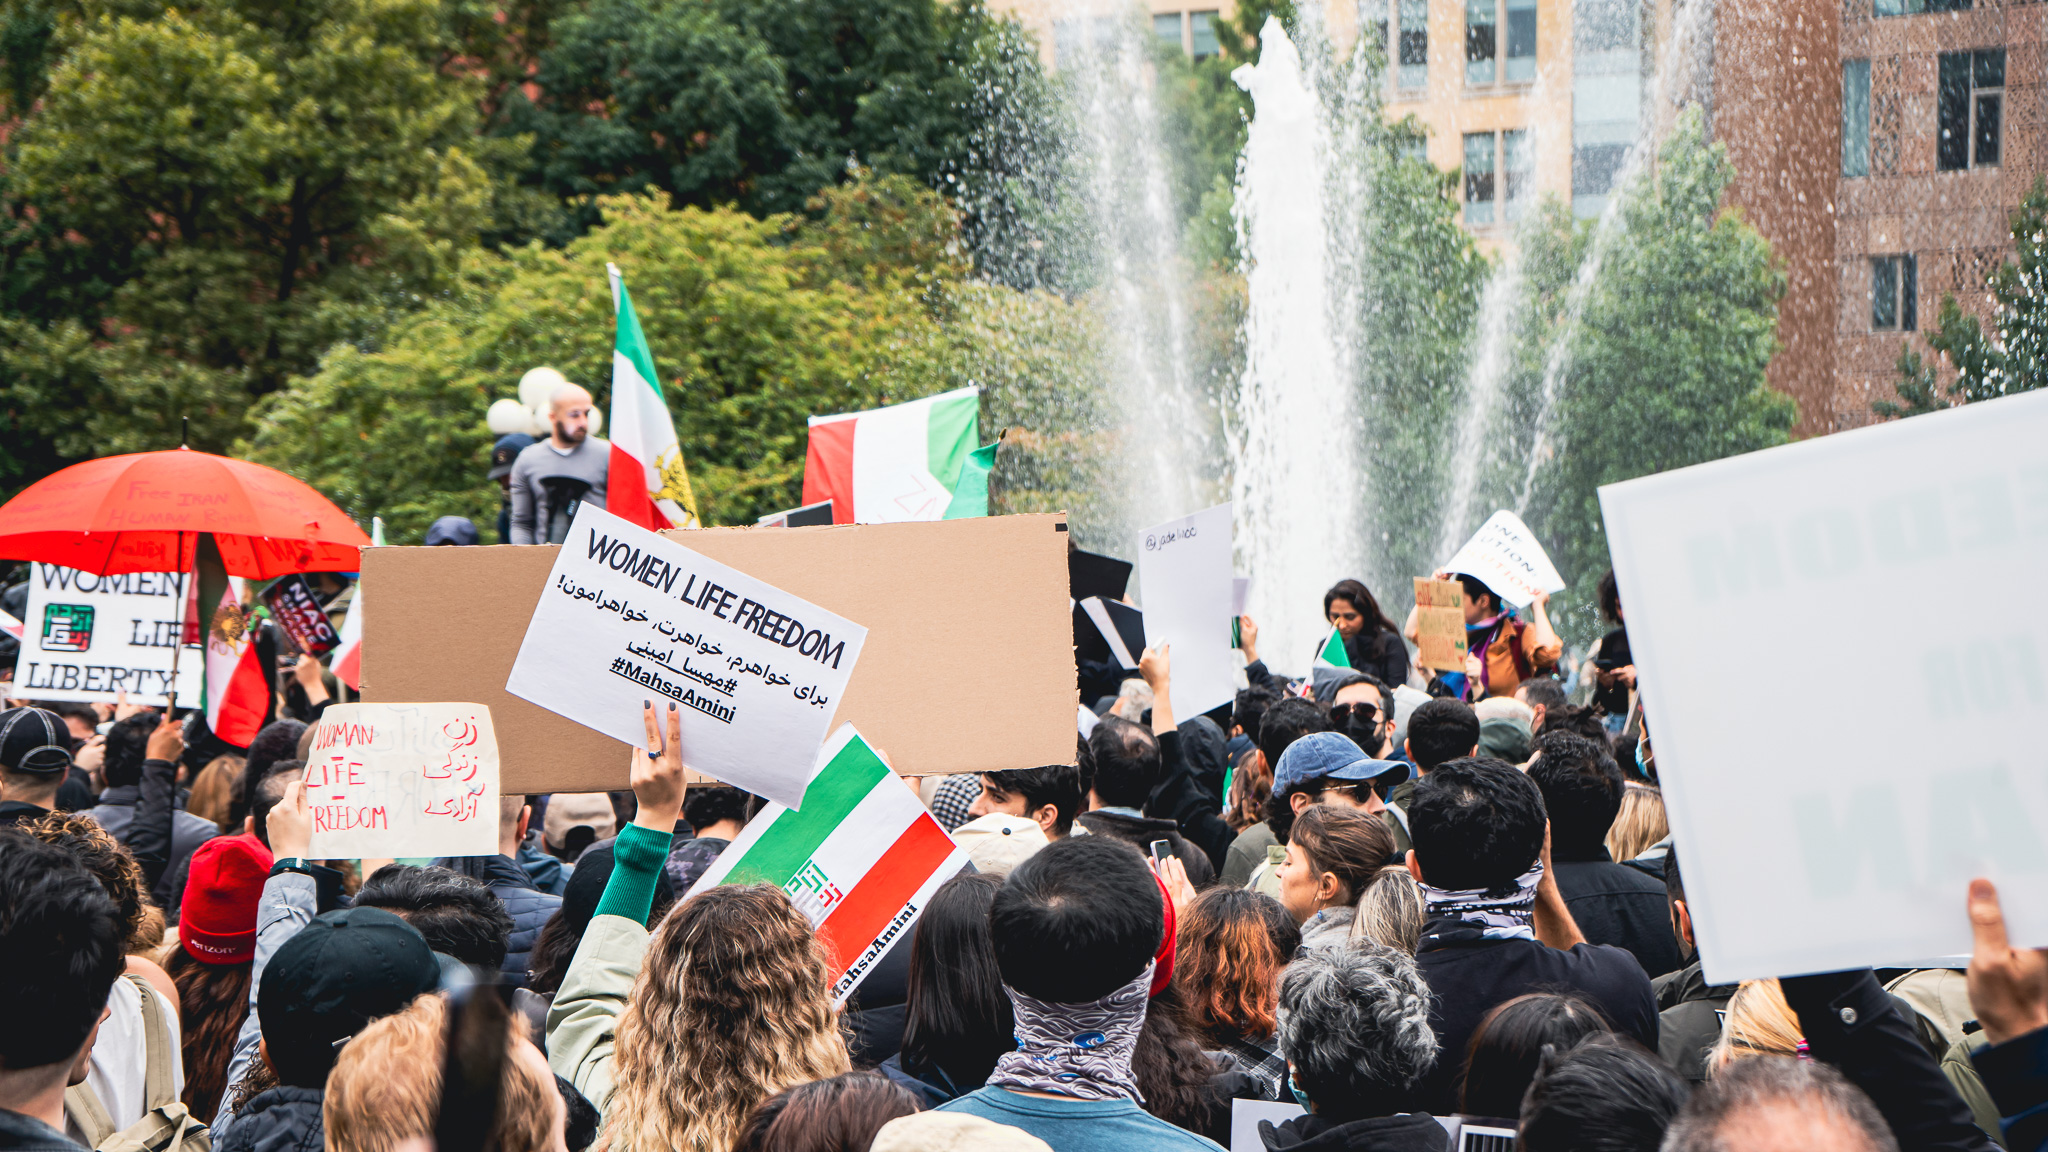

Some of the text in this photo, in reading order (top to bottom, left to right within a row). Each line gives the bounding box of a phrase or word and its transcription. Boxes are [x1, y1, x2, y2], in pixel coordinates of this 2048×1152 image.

[126, 480, 173, 501] Free
[177, 491, 229, 507] IRAN
[106, 508, 191, 528] HUMAN
[38, 562, 187, 598] WOMEN
[288, 581, 333, 642] NIAC
[556, 574, 649, 624] خواهرامون!
[128, 619, 202, 649] LIF
[732, 597, 847, 670] FREEDOM
[25, 662, 180, 696] LIBERTY
[609, 656, 737, 724] #MahsaAmini
[793, 683, 829, 710] برای
[316, 721, 374, 751] WOMAN
[443, 716, 478, 746] زن
[305, 762, 366, 788] LIFE
[423, 742, 478, 782] زندگی
[424, 783, 486, 822] آزادی
[309, 805, 388, 833] REEDOM
